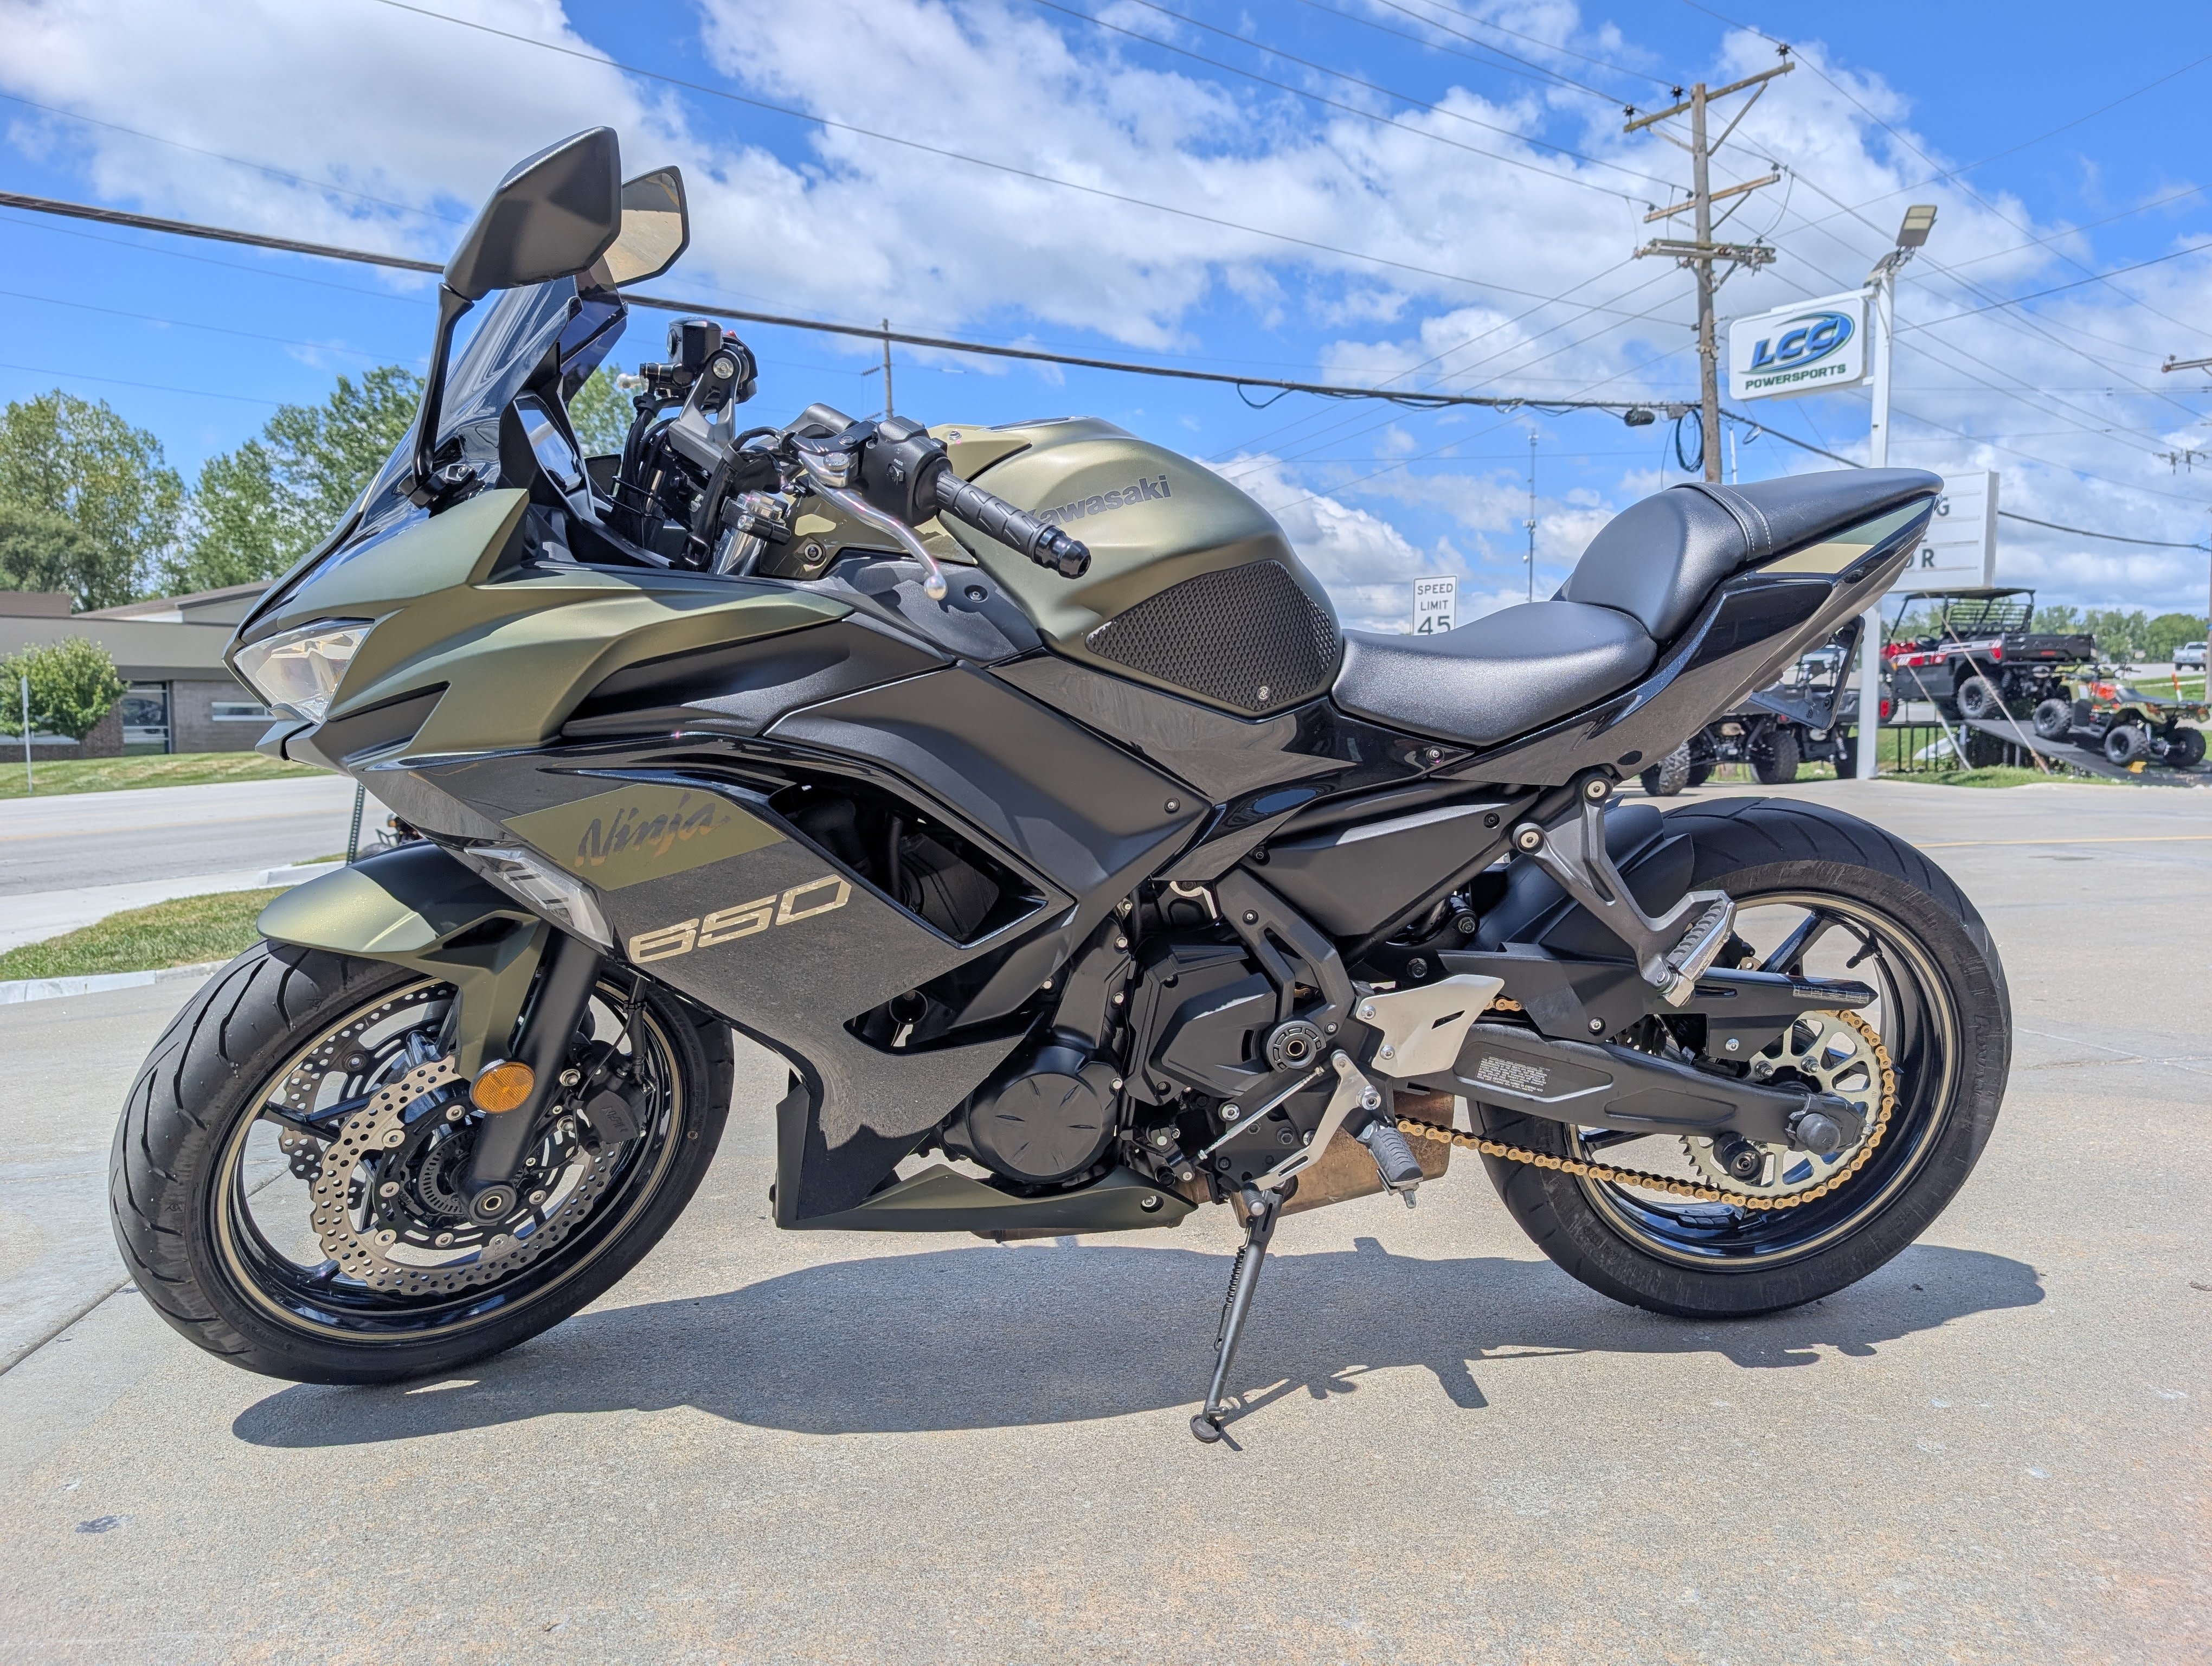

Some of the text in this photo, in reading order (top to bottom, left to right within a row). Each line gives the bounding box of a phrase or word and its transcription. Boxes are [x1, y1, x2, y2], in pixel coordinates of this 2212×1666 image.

[1751, 316, 1842, 371] LCC
[1745, 364, 1847, 390] POWERSPORTS
[1028, 475, 1172, 527] awasaki
[1417, 583, 1454, 595] SPEED
[1420, 600, 1449, 611] LIMIT
[1417, 616, 1451, 635] 45
[574, 791, 731, 868] Ninja
[629, 874, 852, 964] 650
